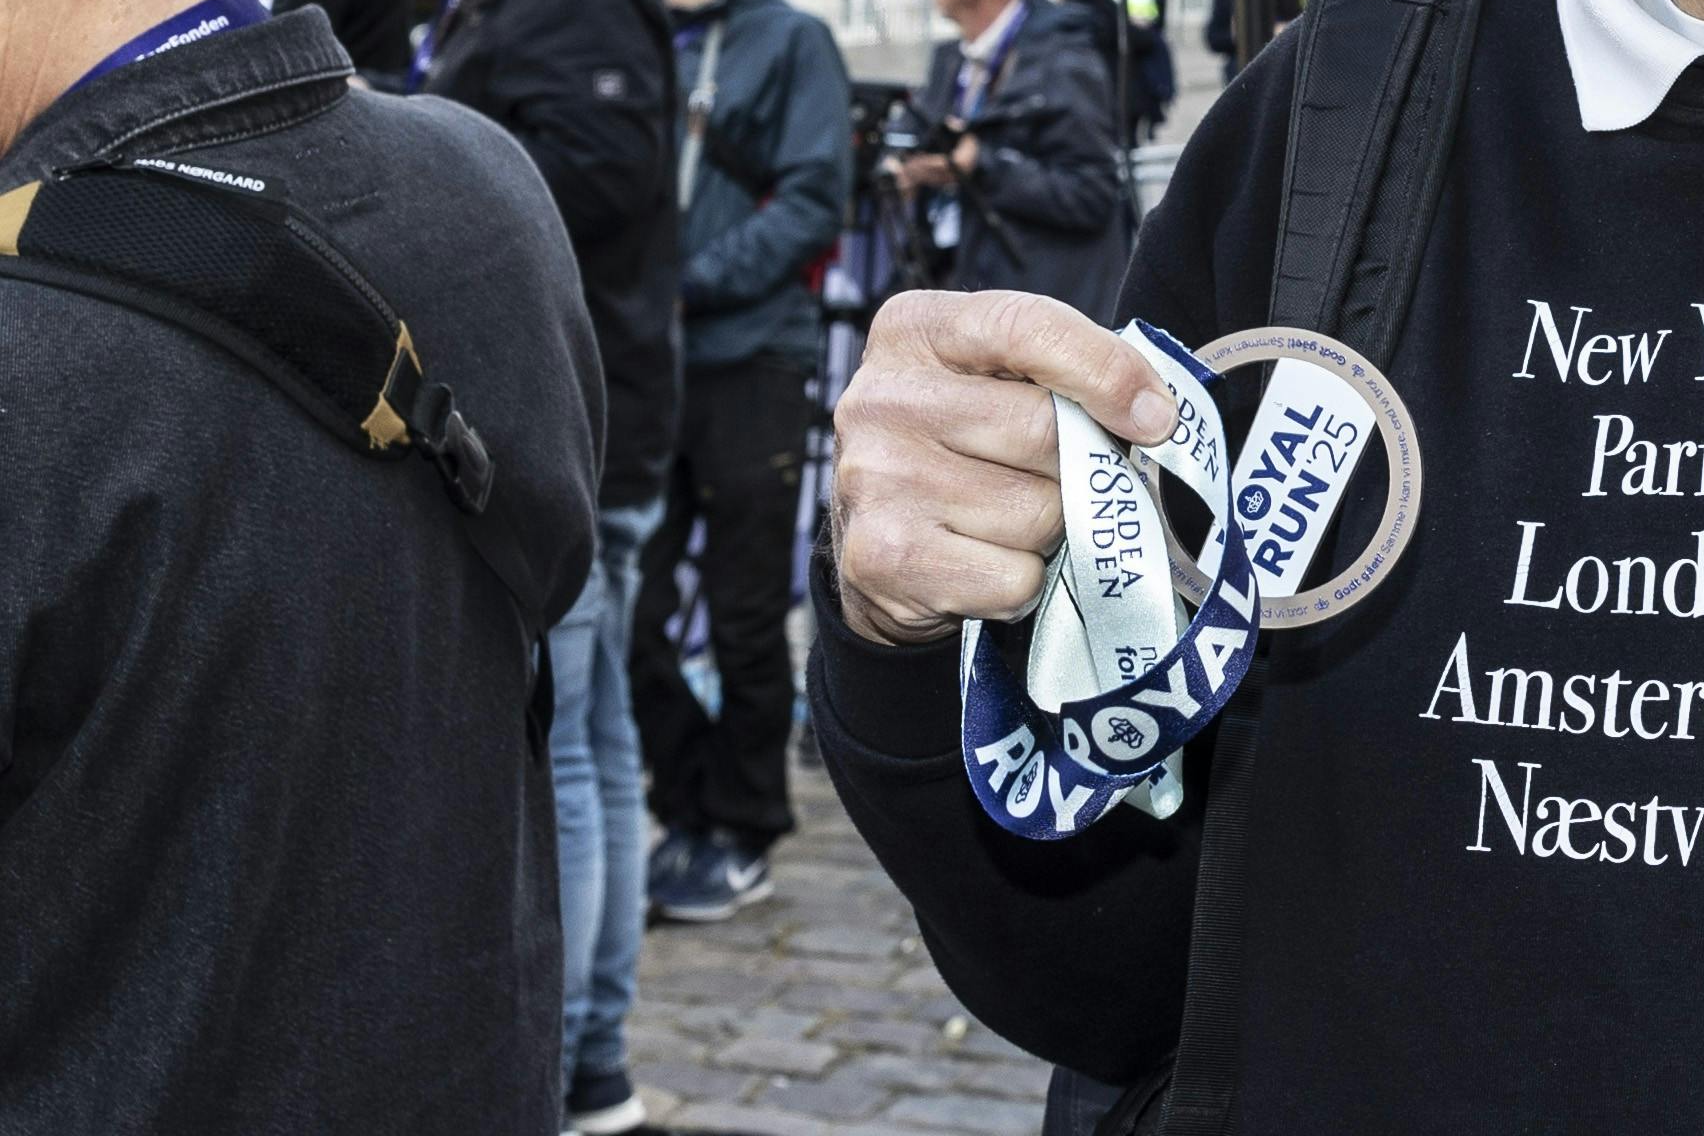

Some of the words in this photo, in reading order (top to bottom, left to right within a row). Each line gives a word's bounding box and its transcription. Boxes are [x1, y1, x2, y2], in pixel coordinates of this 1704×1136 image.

[135, 16, 230, 62] Fonden
[178, 163, 265, 192] NØRGAARD
[1318, 345, 1348, 367] Godt
[1512, 300, 1672, 385] New
[1168, 381, 1219, 458] DEA
[1169, 419, 1220, 483] DEN
[1088, 452, 1123, 599] FONDEN
[1332, 576, 1362, 601] Godt
[975, 723, 1135, 832] ROY
